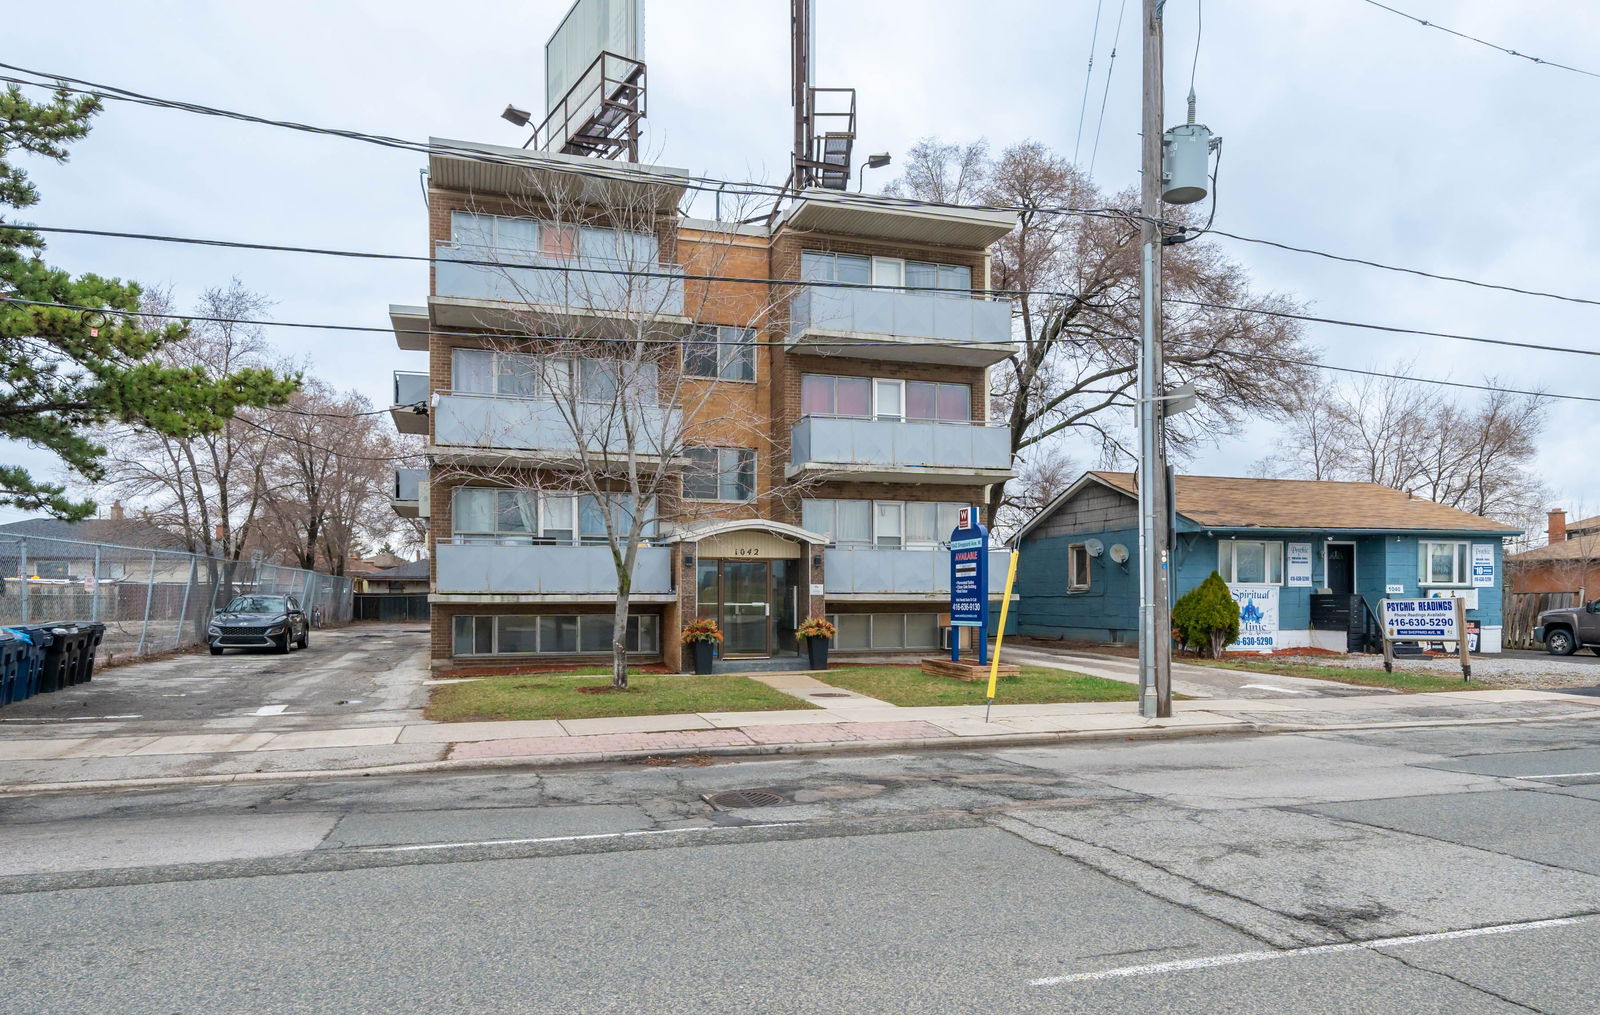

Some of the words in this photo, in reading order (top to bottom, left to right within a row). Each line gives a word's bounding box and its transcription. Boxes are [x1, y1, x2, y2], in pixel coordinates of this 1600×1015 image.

[960, 510, 968, 520] W
[734, 548, 760, 556] 1042
[955, 551, 978, 561] AVAILABLE
[1231, 589, 1271, 602] Spiritual
[952, 603, 981, 611] 416-636-9130
[1386, 602, 1415, 611] PSYCHIC
[1418, 601, 1453, 611] READINGS
[1388, 618, 1454, 627] 416-630-5290
[1232, 636, 1273, 645] 6-630-5290
